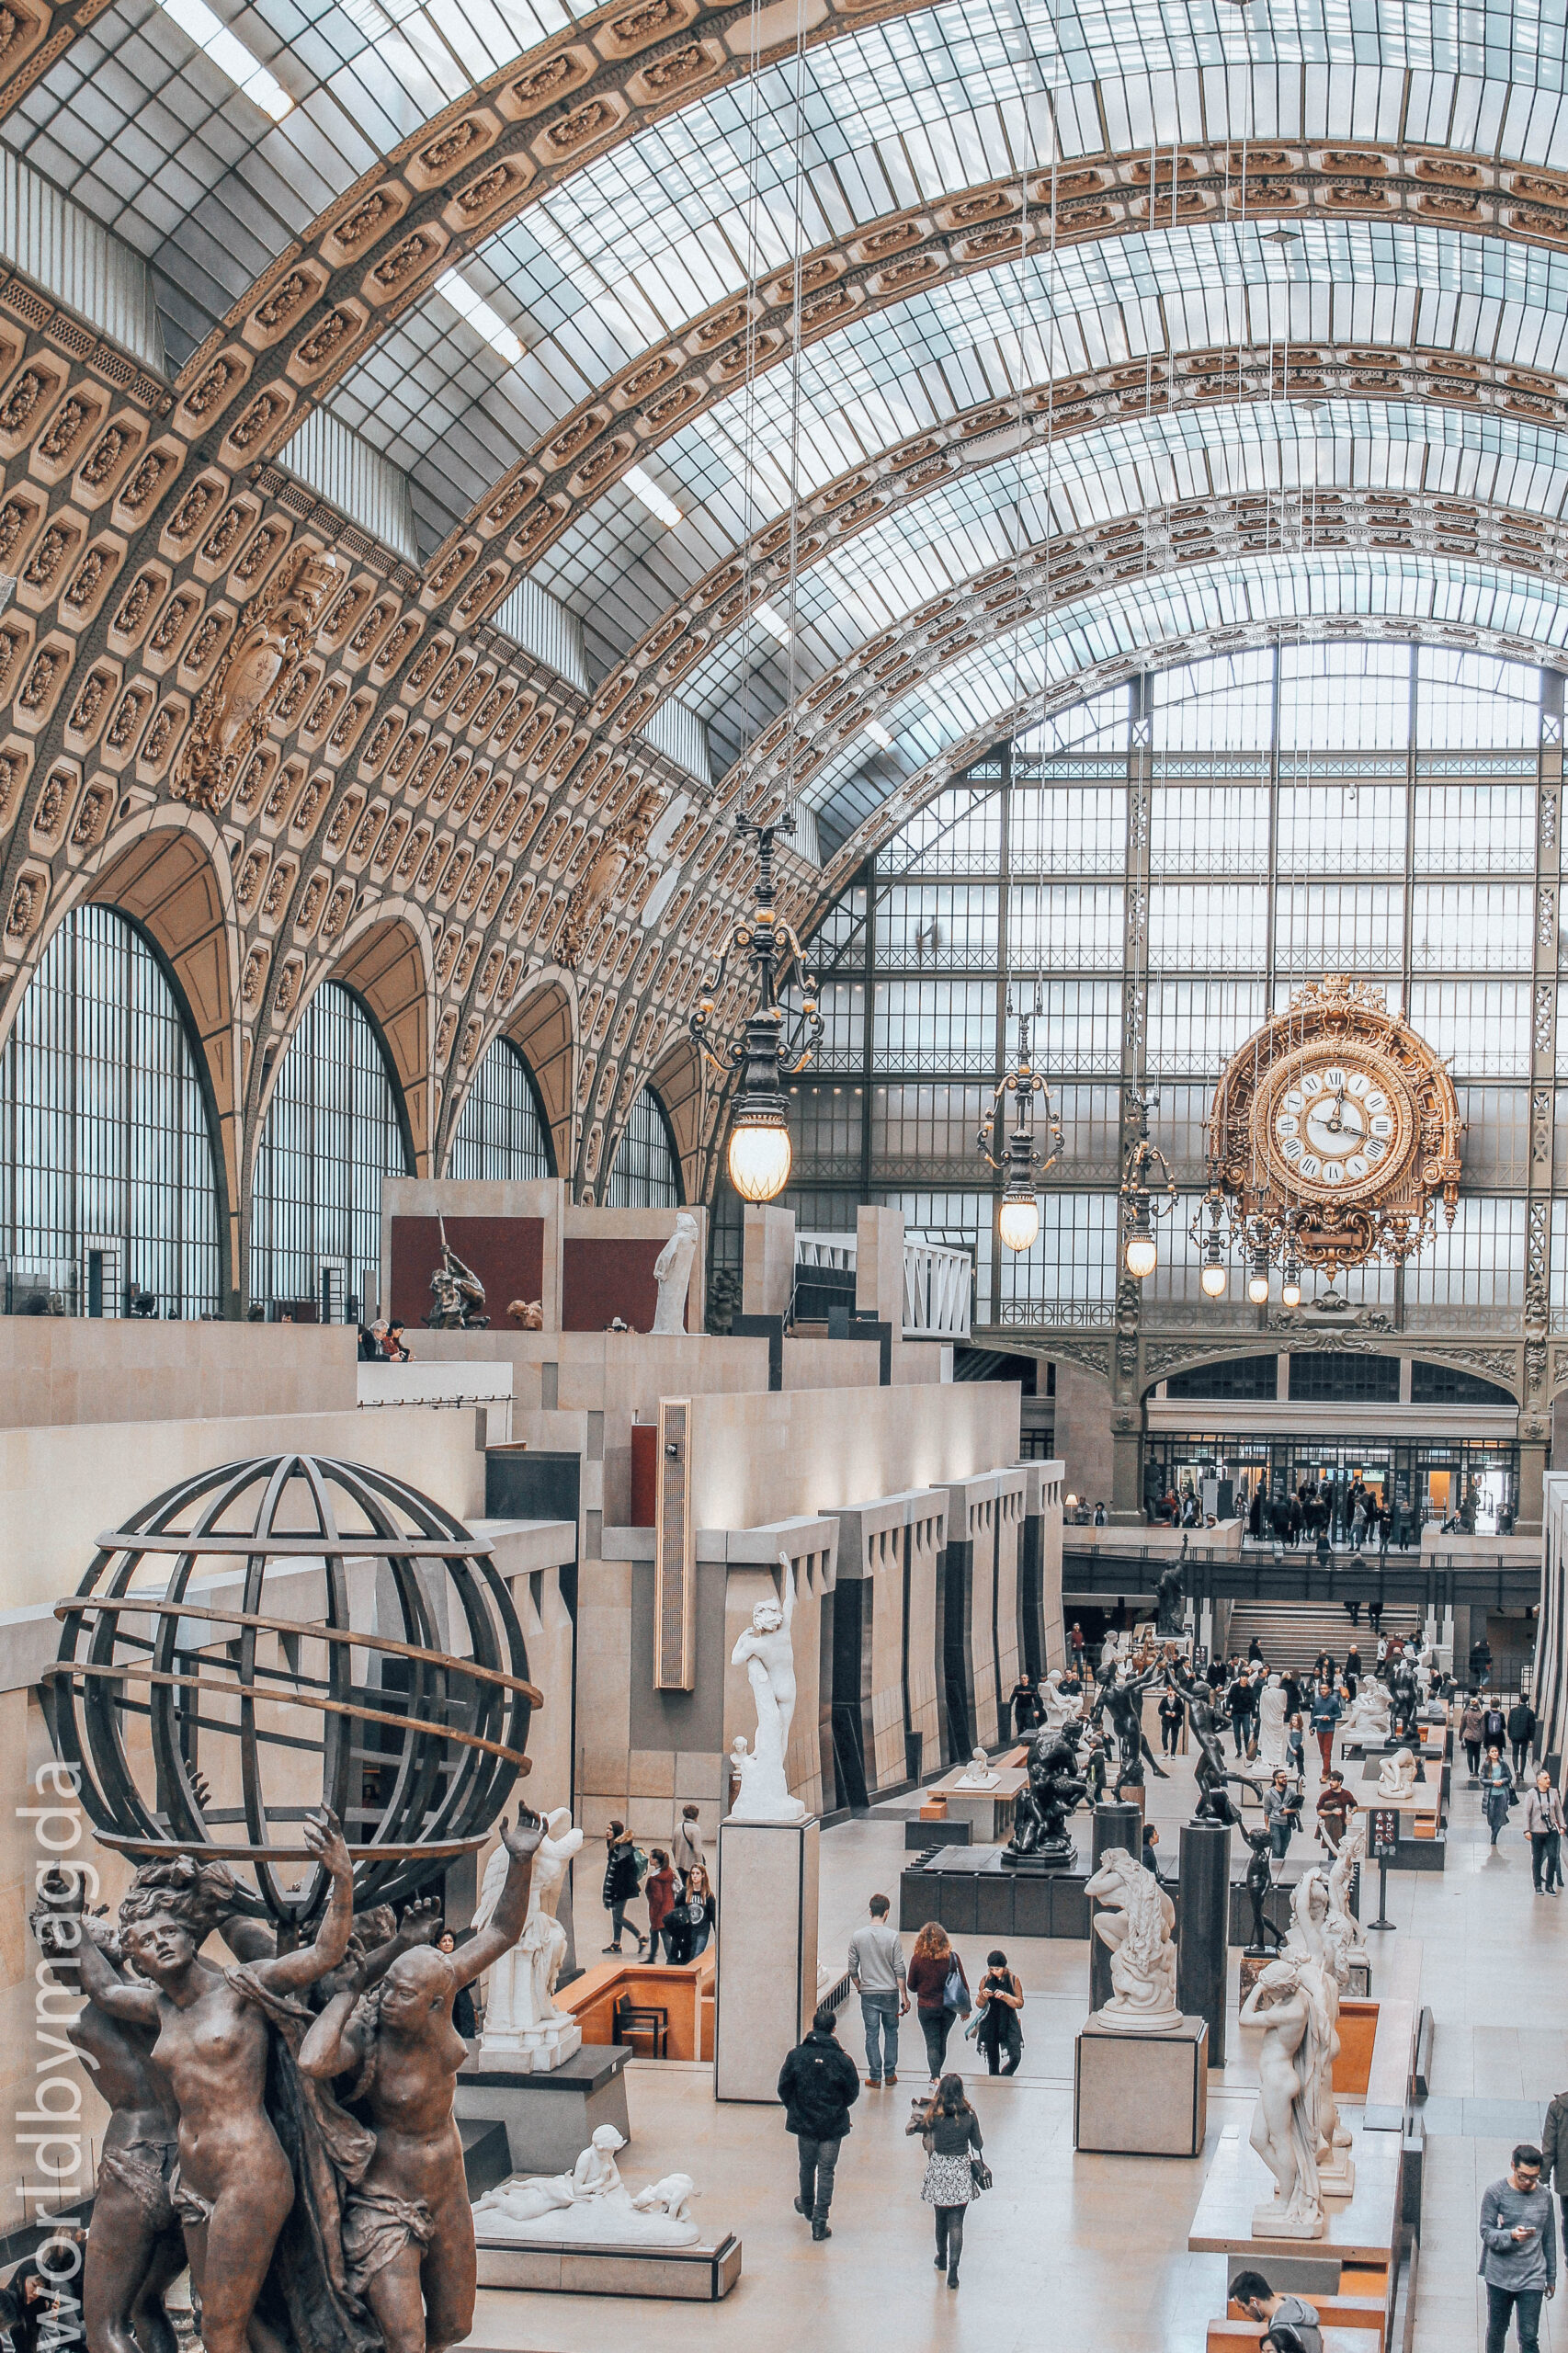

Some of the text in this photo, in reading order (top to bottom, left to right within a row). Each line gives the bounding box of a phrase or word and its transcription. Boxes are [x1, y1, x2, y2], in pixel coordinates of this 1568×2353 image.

[1329, 1073, 1342, 1085] XII
[1355, 1079, 1363, 1091] I
[1369, 1097, 1382, 1108] II
[1376, 1121, 1388, 1131] III
[1328, 1166, 1339, 1178] VI
